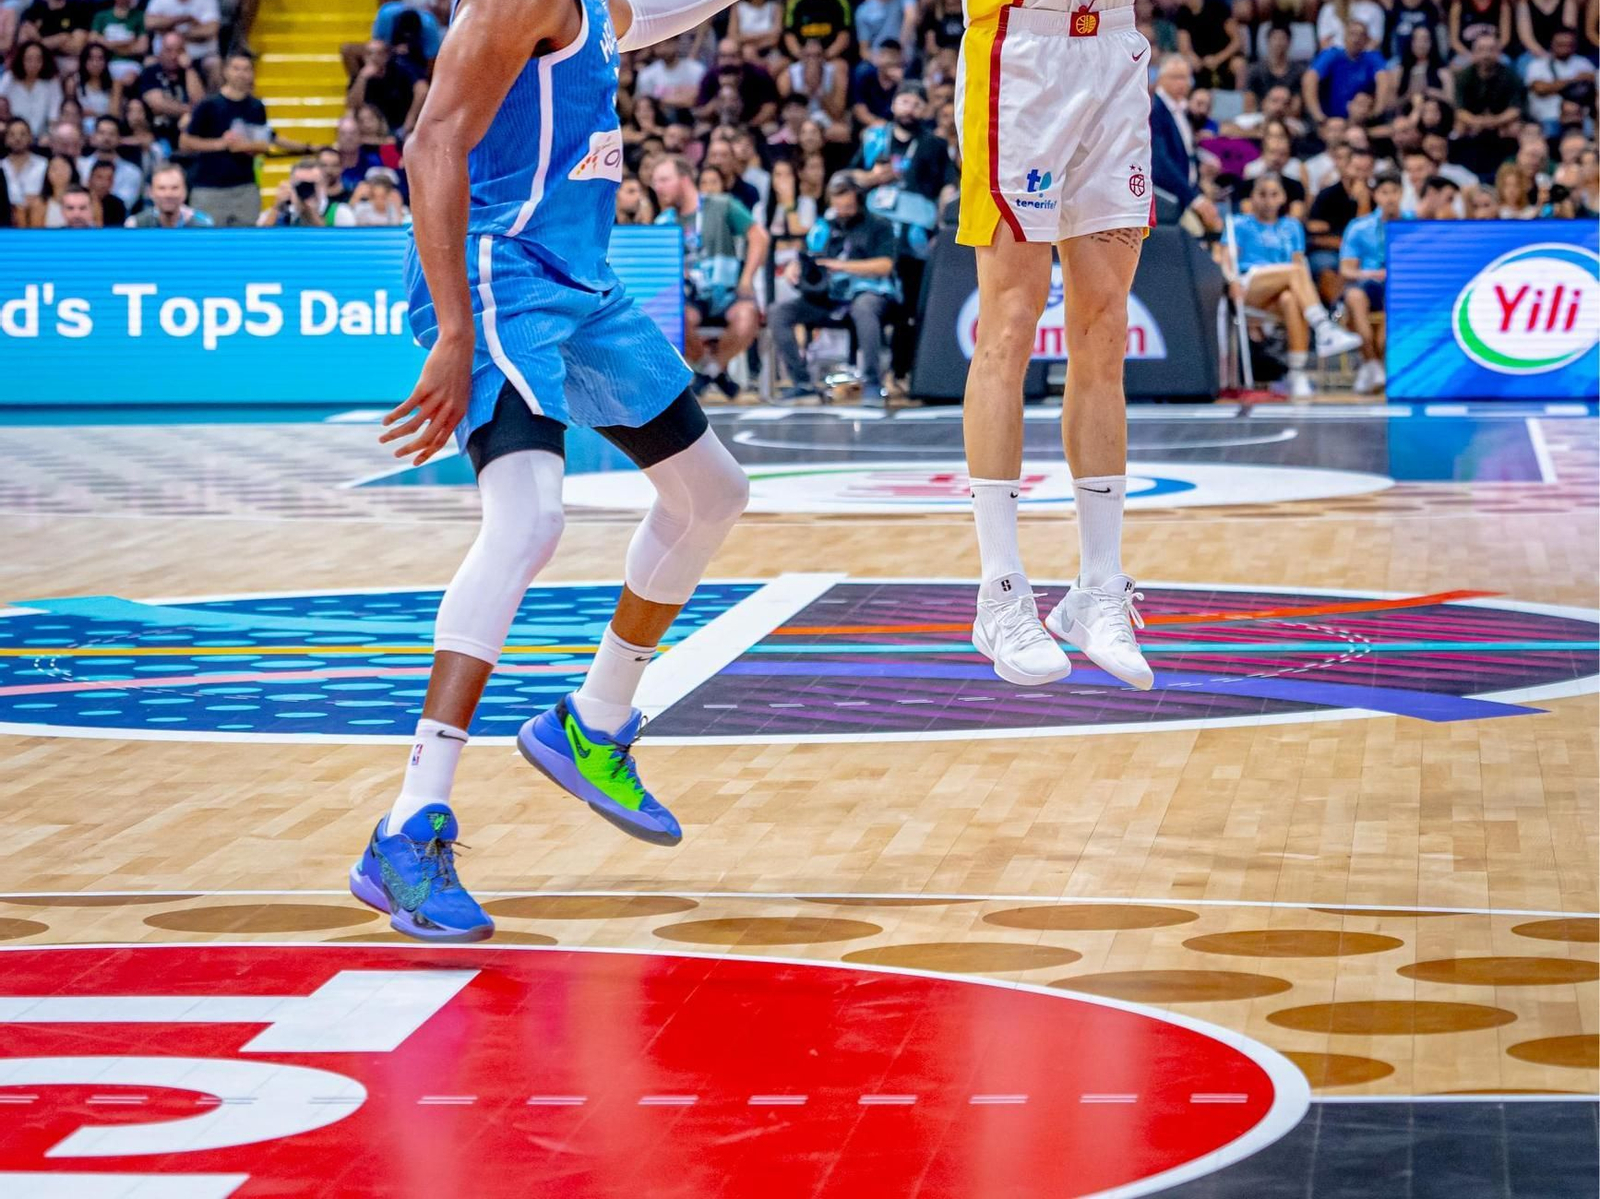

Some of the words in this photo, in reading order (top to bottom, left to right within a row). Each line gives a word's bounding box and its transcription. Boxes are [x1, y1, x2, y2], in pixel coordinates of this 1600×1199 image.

[112, 282, 284, 351] Top5
[300, 289, 421, 347] Dair
[1494, 283, 1582, 333] Yili
